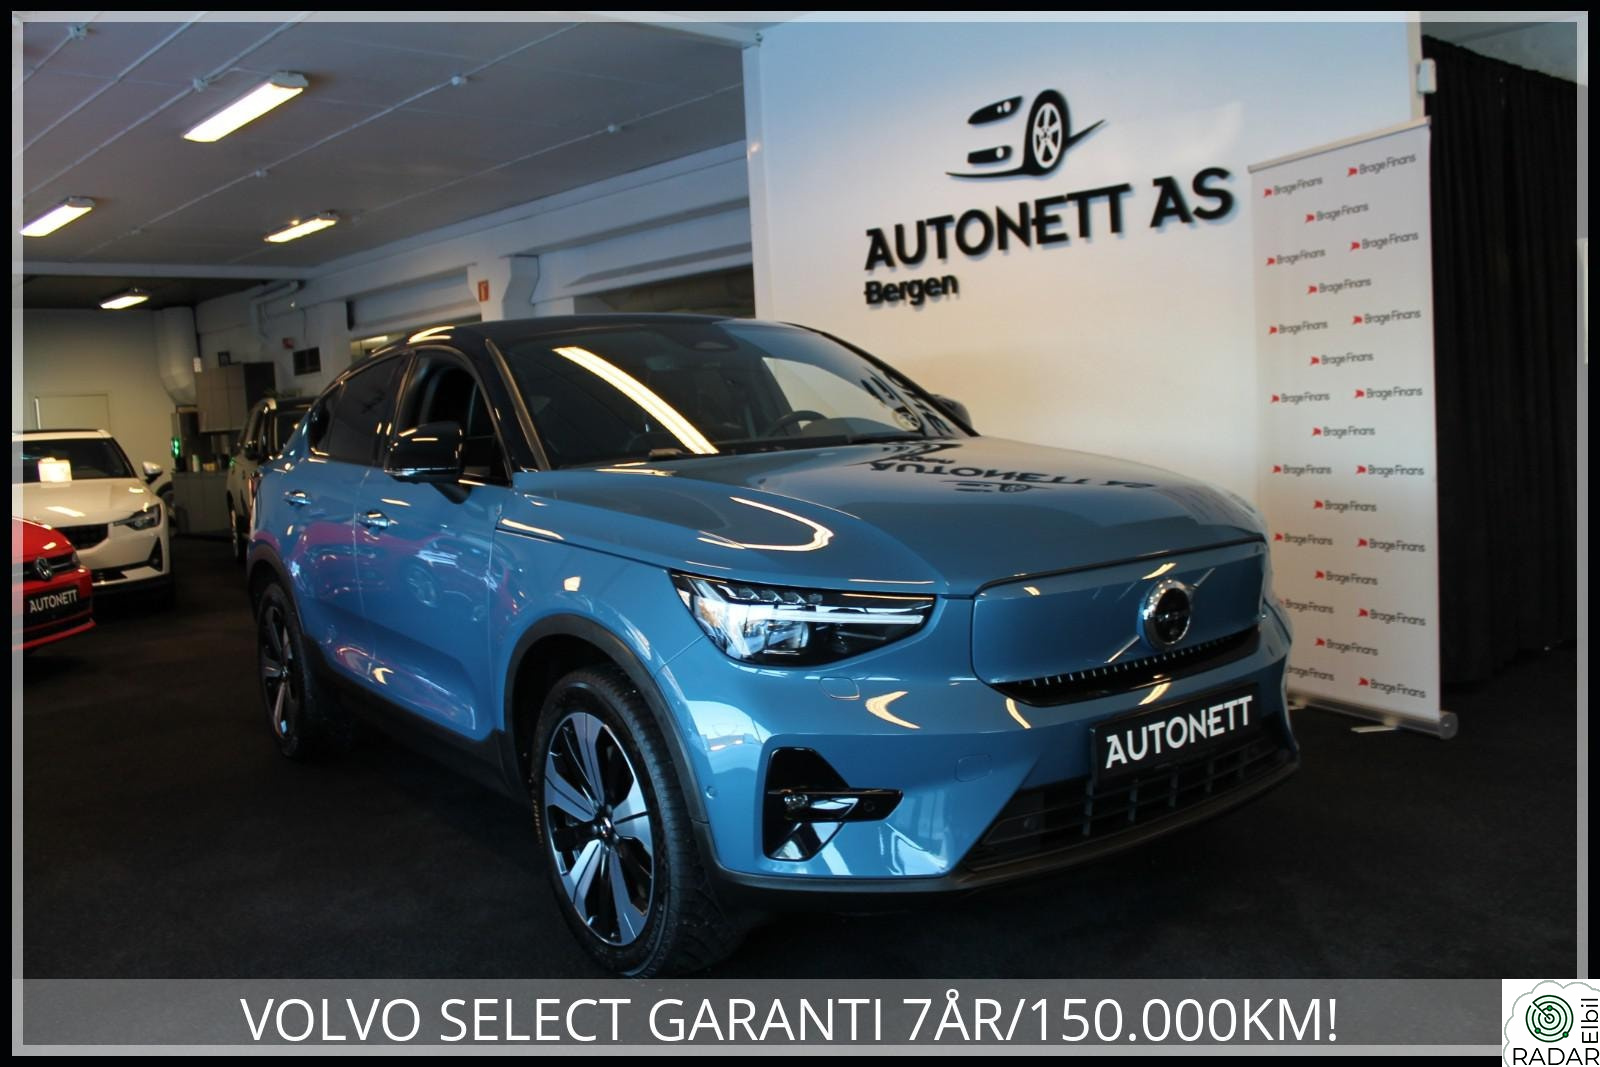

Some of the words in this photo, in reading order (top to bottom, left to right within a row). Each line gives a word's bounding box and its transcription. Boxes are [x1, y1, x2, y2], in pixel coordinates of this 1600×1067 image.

[1359, 161, 1385, 174] Brage
[1386, 154, 1416, 167] Finans
[1274, 184, 1296, 196] Brage
[1297, 177, 1322, 189] Finans
[864, 183, 1131, 271] AUTONETT
[1150, 167, 1234, 228] AS
[1316, 209, 1340, 221] Brage
[1341, 203, 1368, 215] Finans
[1362, 237, 1388, 249] Brage
[1389, 232, 1418, 244] Finans
[1277, 254, 1299, 265] Brage
[1300, 249, 1325, 260] Finans
[864, 274, 959, 306] Bergen
[1319, 282, 1343, 294] Brage
[1344, 278, 1371, 289] Finans
[1364, 312, 1391, 325] Brage
[1392, 310, 1420, 320] Finans
[1279, 324, 1301, 335] Brage
[1302, 321, 1327, 331] Finans
[1321, 355, 1345, 366] Brage
[1346, 352, 1373, 362] Finans
[1281, 394, 1304, 405] Brage
[1304, 392, 1329, 400] Finans
[1367, 388, 1392, 400] Brage
[1393, 387, 1422, 396] Finans
[1323, 427, 1347, 439] Brage
[1348, 426, 1375, 436] Finans
[1283, 465, 1305, 476] Brage
[1306, 465, 1331, 474] Finans
[1368, 465, 1394, 478] Brage
[1395, 465, 1424, 476] Finans
[1325, 500, 1349, 513] Brage
[1350, 500, 1376, 512] Finans
[1284, 534, 1307, 546] Brage
[1308, 535, 1332, 545] Finans
[1369, 539, 1396, 552] Brage
[1396, 541, 1425, 552] Finans
[1326, 571, 1350, 585] Brage
[1351, 573, 1378, 585] Finans
[29, 589, 78, 613] AUTONETT
[1285, 600, 1308, 613] Brage
[1309, 602, 1334, 614] Finans
[1370, 610, 1396, 624] Brage
[1397, 613, 1425, 626] Finans
[1327, 640, 1350, 653] Brage
[1351, 643, 1378, 656] Finans
[1310, 668, 1334, 681] Finans
[1371, 679, 1396, 694] Brage
[1398, 684, 1425, 698] Finans
[1105, 695, 1253, 769] AUTONETT
